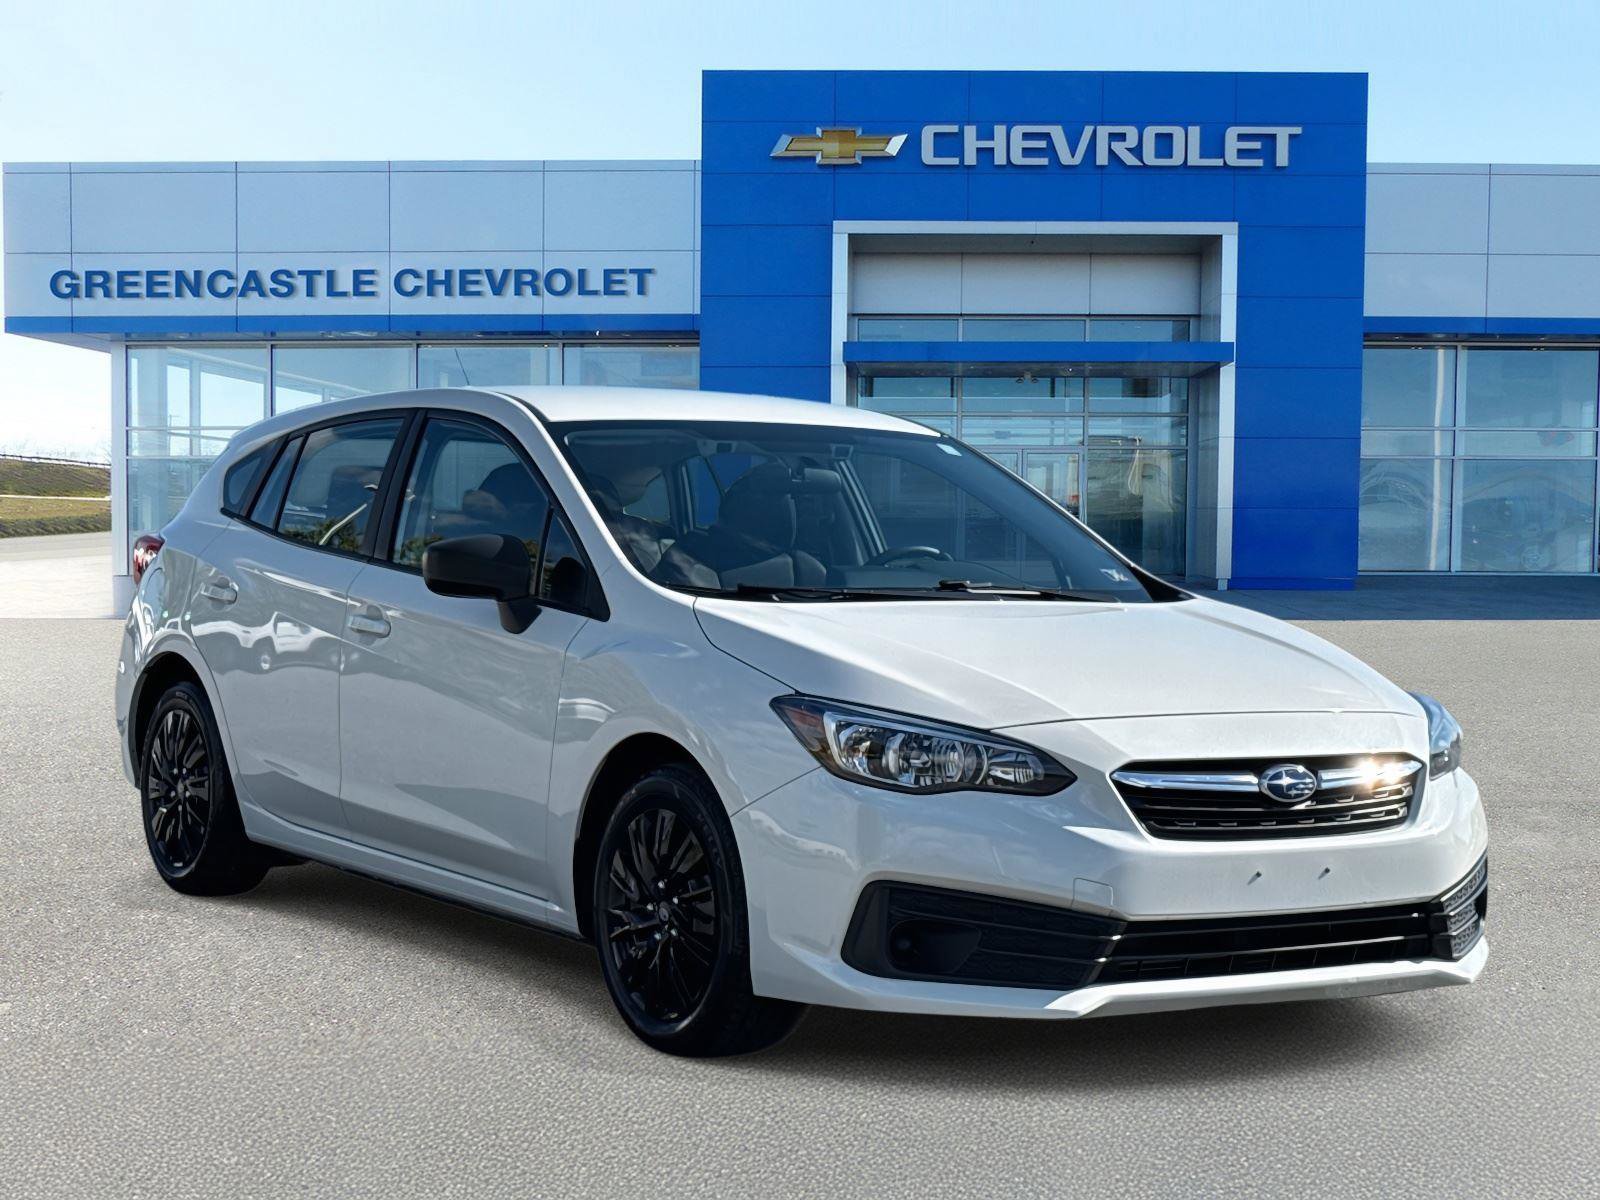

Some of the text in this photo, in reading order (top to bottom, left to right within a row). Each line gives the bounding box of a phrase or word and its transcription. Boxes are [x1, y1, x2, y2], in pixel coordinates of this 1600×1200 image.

[921, 124, 1303, 168] CHEVROLET
[49, 268, 655, 299] GREENCASTLE CHEVROLET
